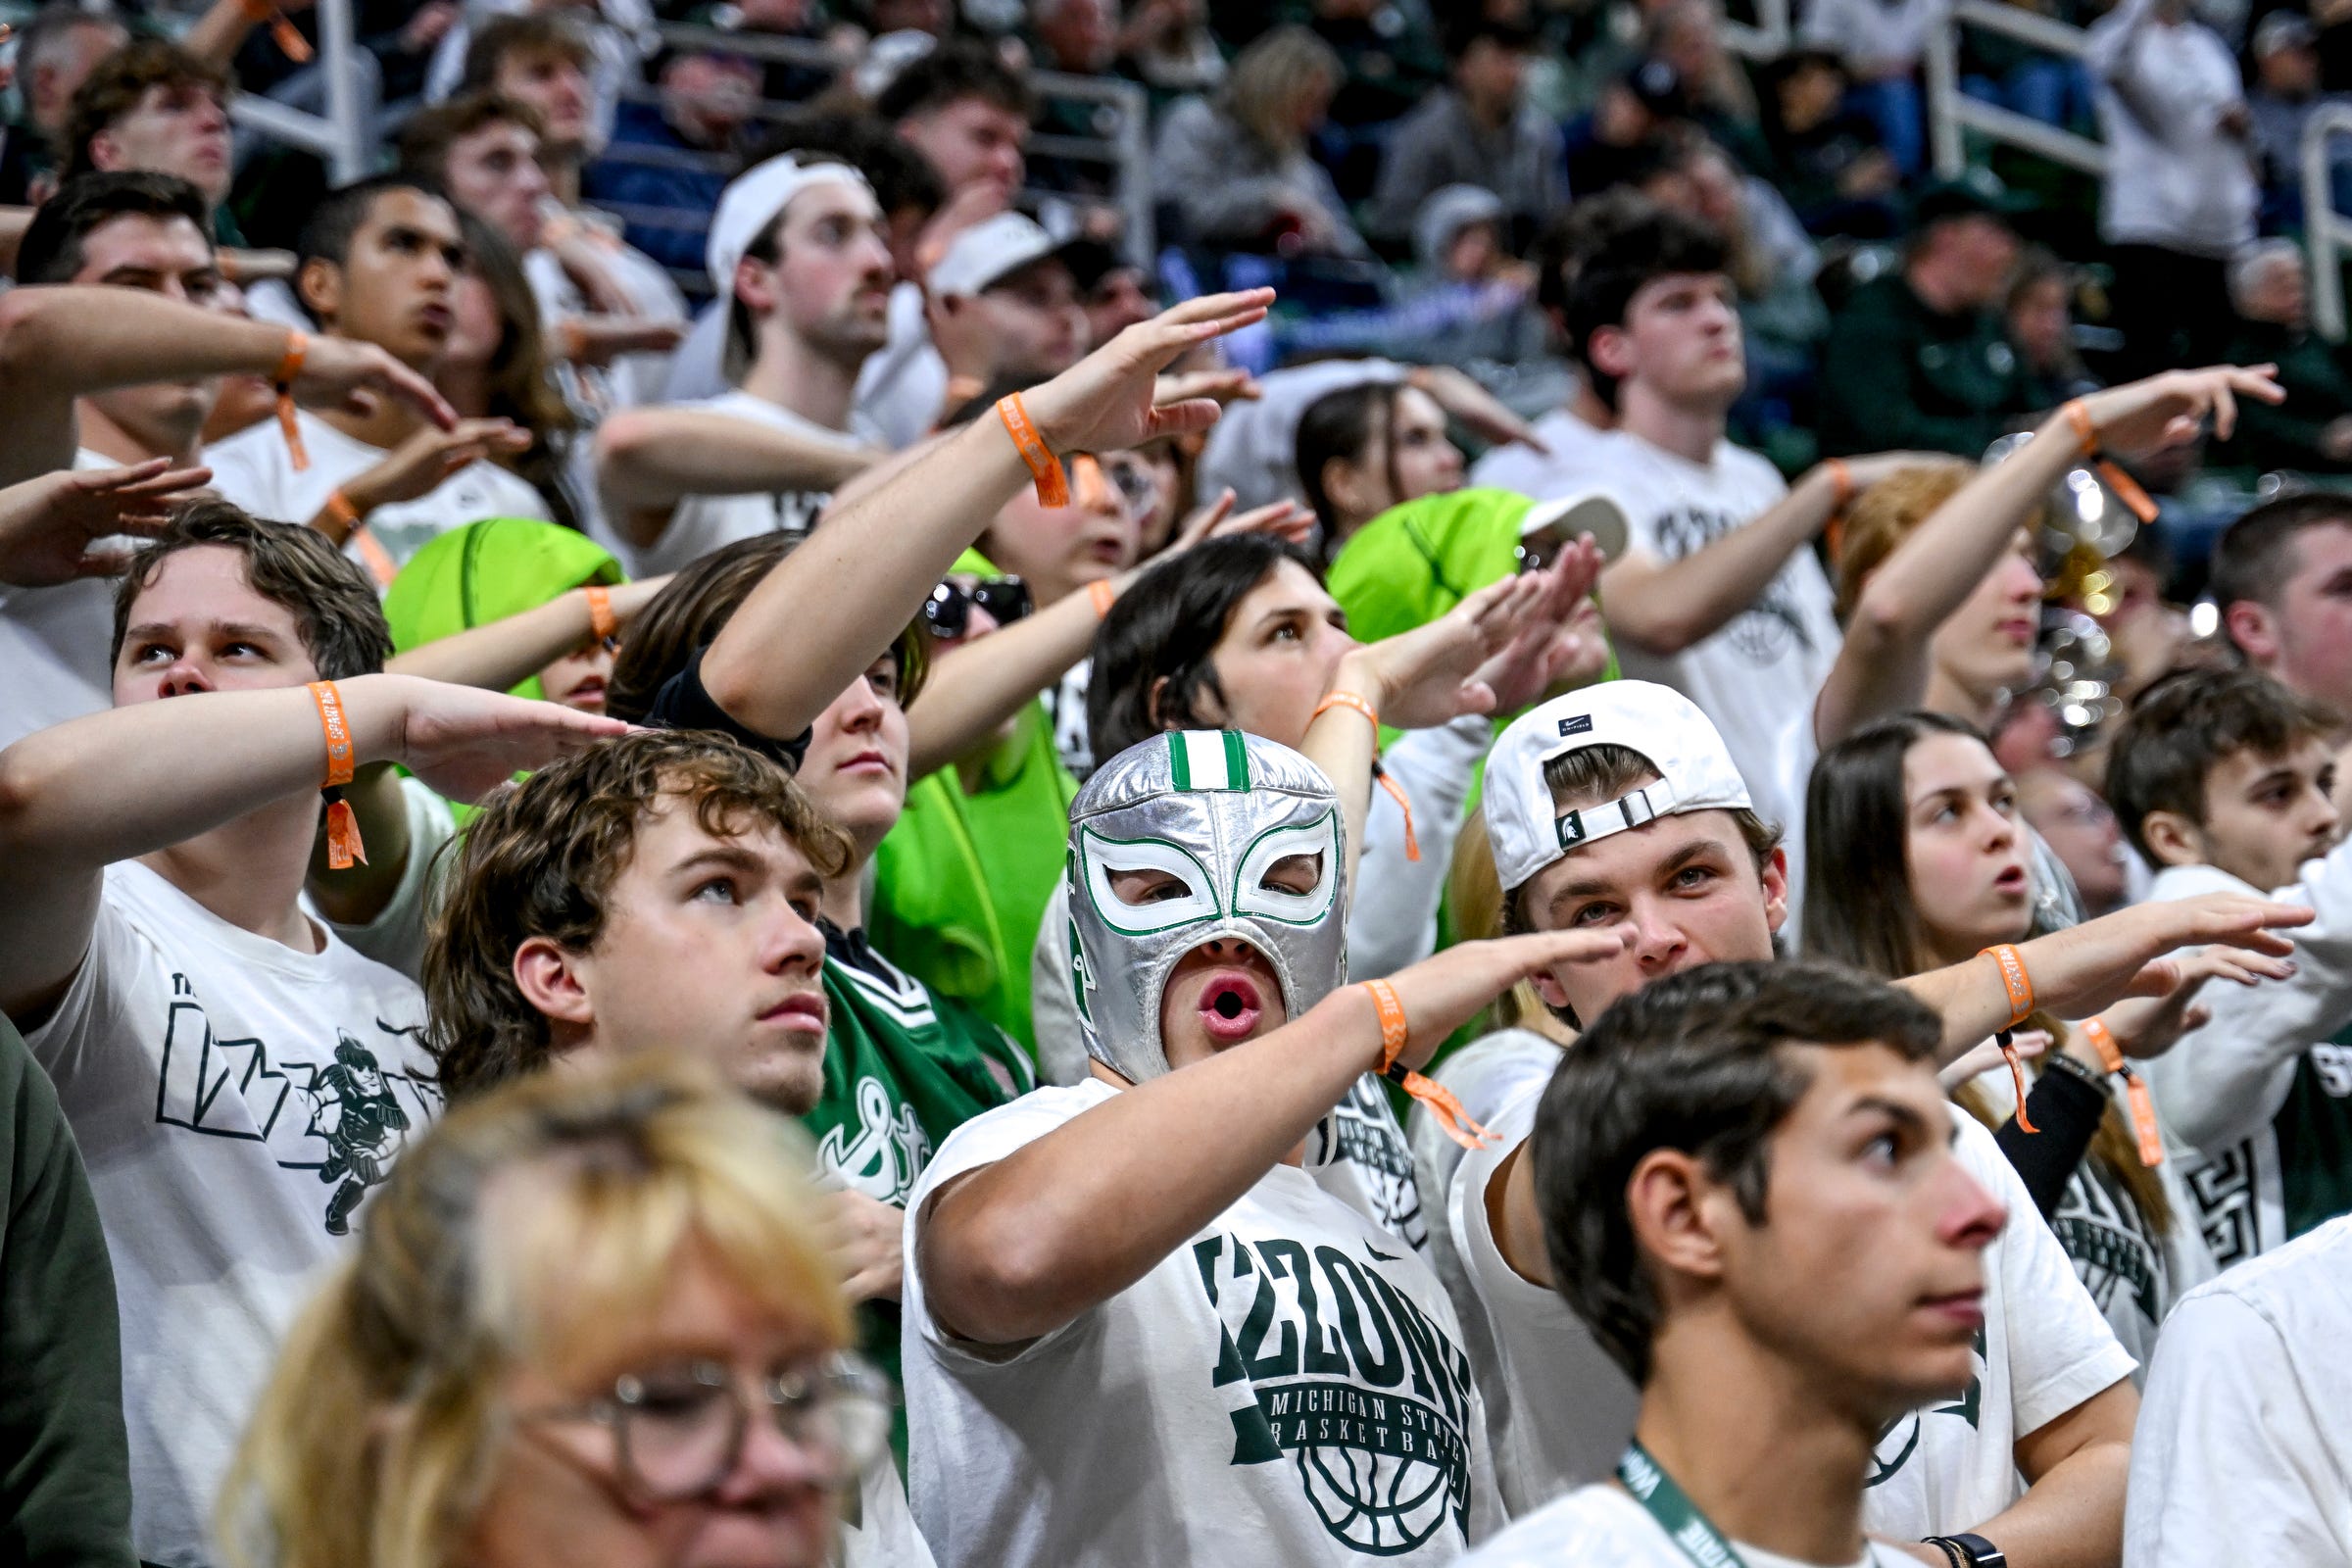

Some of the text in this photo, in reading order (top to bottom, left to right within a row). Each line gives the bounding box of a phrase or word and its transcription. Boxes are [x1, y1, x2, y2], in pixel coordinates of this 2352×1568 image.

[1271, 1390, 1459, 1461] MICHIGAN STATE
[1271, 1420, 1456, 1488] BASKETBAL
